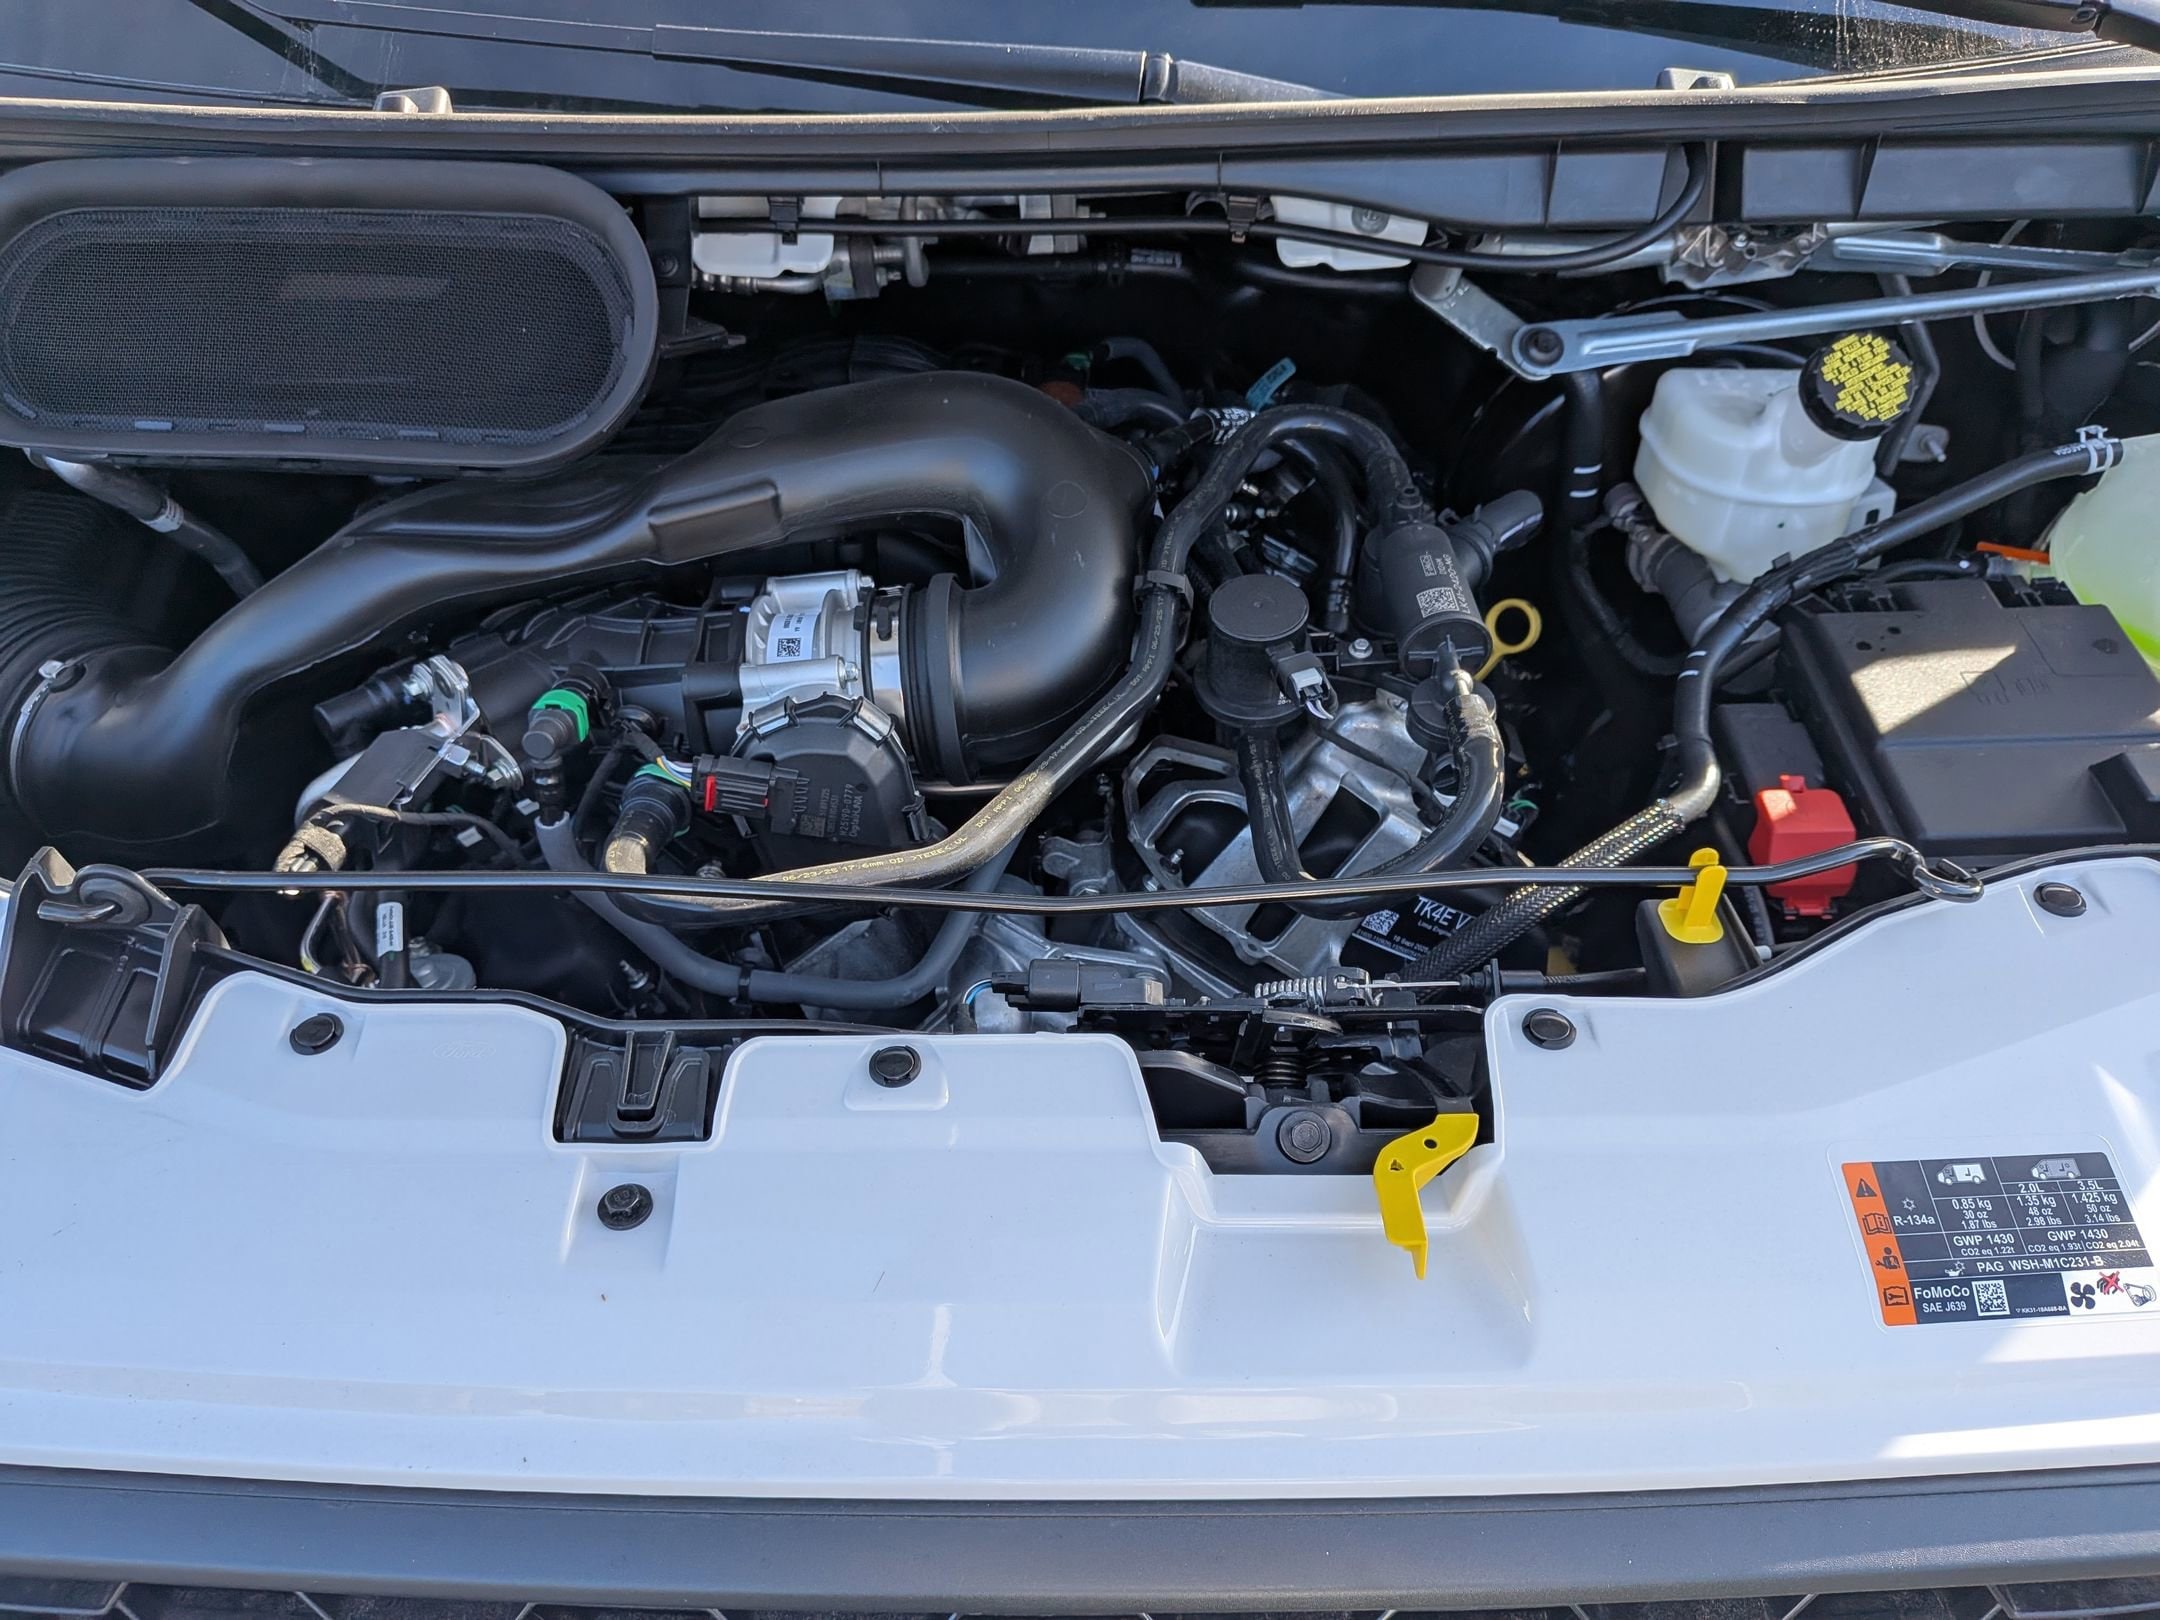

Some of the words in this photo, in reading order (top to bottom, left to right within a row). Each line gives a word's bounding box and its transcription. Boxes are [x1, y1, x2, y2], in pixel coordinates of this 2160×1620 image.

[975, 814, 992, 828] DOT
[783, 867, 838, 881] 06/23/25
[2018, 1183, 2045, 1193] 2.0L
[2077, 1180, 2104, 1191] 3.5L
[1951, 1198, 1976, 1210] 0.85
[1977, 1197, 1992, 1211] kg
[2017, 1196, 2040, 1206] 1.35
[2041, 1194, 2057, 1208] kg
[2071, 1192, 2101, 1204] 1.425
[2102, 1191, 2118, 1205] kg
[2028, 1207, 2040, 1216] 48
[2041, 1207, 2053, 1216] oz
[2086, 1204, 2097, 1213] 50
[2099, 1205, 2111, 1213] oz
[1893, 1214, 1936, 1226] R-134a
[1962, 1210, 1975, 1220] 30
[1976, 1211, 1989, 1219] oz
[2084, 1214, 2105, 1223] 3.14
[2105, 1213, 2120, 1222] lbs
[1961, 1219, 1980, 1230] 1.87
[1982, 1219, 1997, 1229] lbs
[2025, 1217, 2046, 1227] 2.98
[2047, 1216, 2062, 1225] lbs
[1953, 1235, 1983, 1246] GWP
[1986, 1233, 2015, 1245] 1430
[2047, 1230, 2077, 1241] GWP
[2080, 1228, 2109, 1240] 1430
[1960, 1248, 1980, 1256] CO2
[1981, 1249, 1994, 1257] eq
[1994, 1246, 2015, 1255] 1.22t
[2027, 1244, 2047, 1253] CO2
[2048, 1245, 2060, 1253] eq
[2061, 1241, 2082, 1251] 1.93t
[2085, 1241, 2105, 1249] CO2
[2106, 1242, 2118, 1250] eq
[1976, 1261, 2004, 1273] PAG
[2008, 1255, 2104, 1271] WSH-M1C231-B
[1913, 1285, 1970, 1300] FoMoCo
[1922, 1301, 1943, 1313] SAE
[1944, 1300, 1967, 1312] J639
